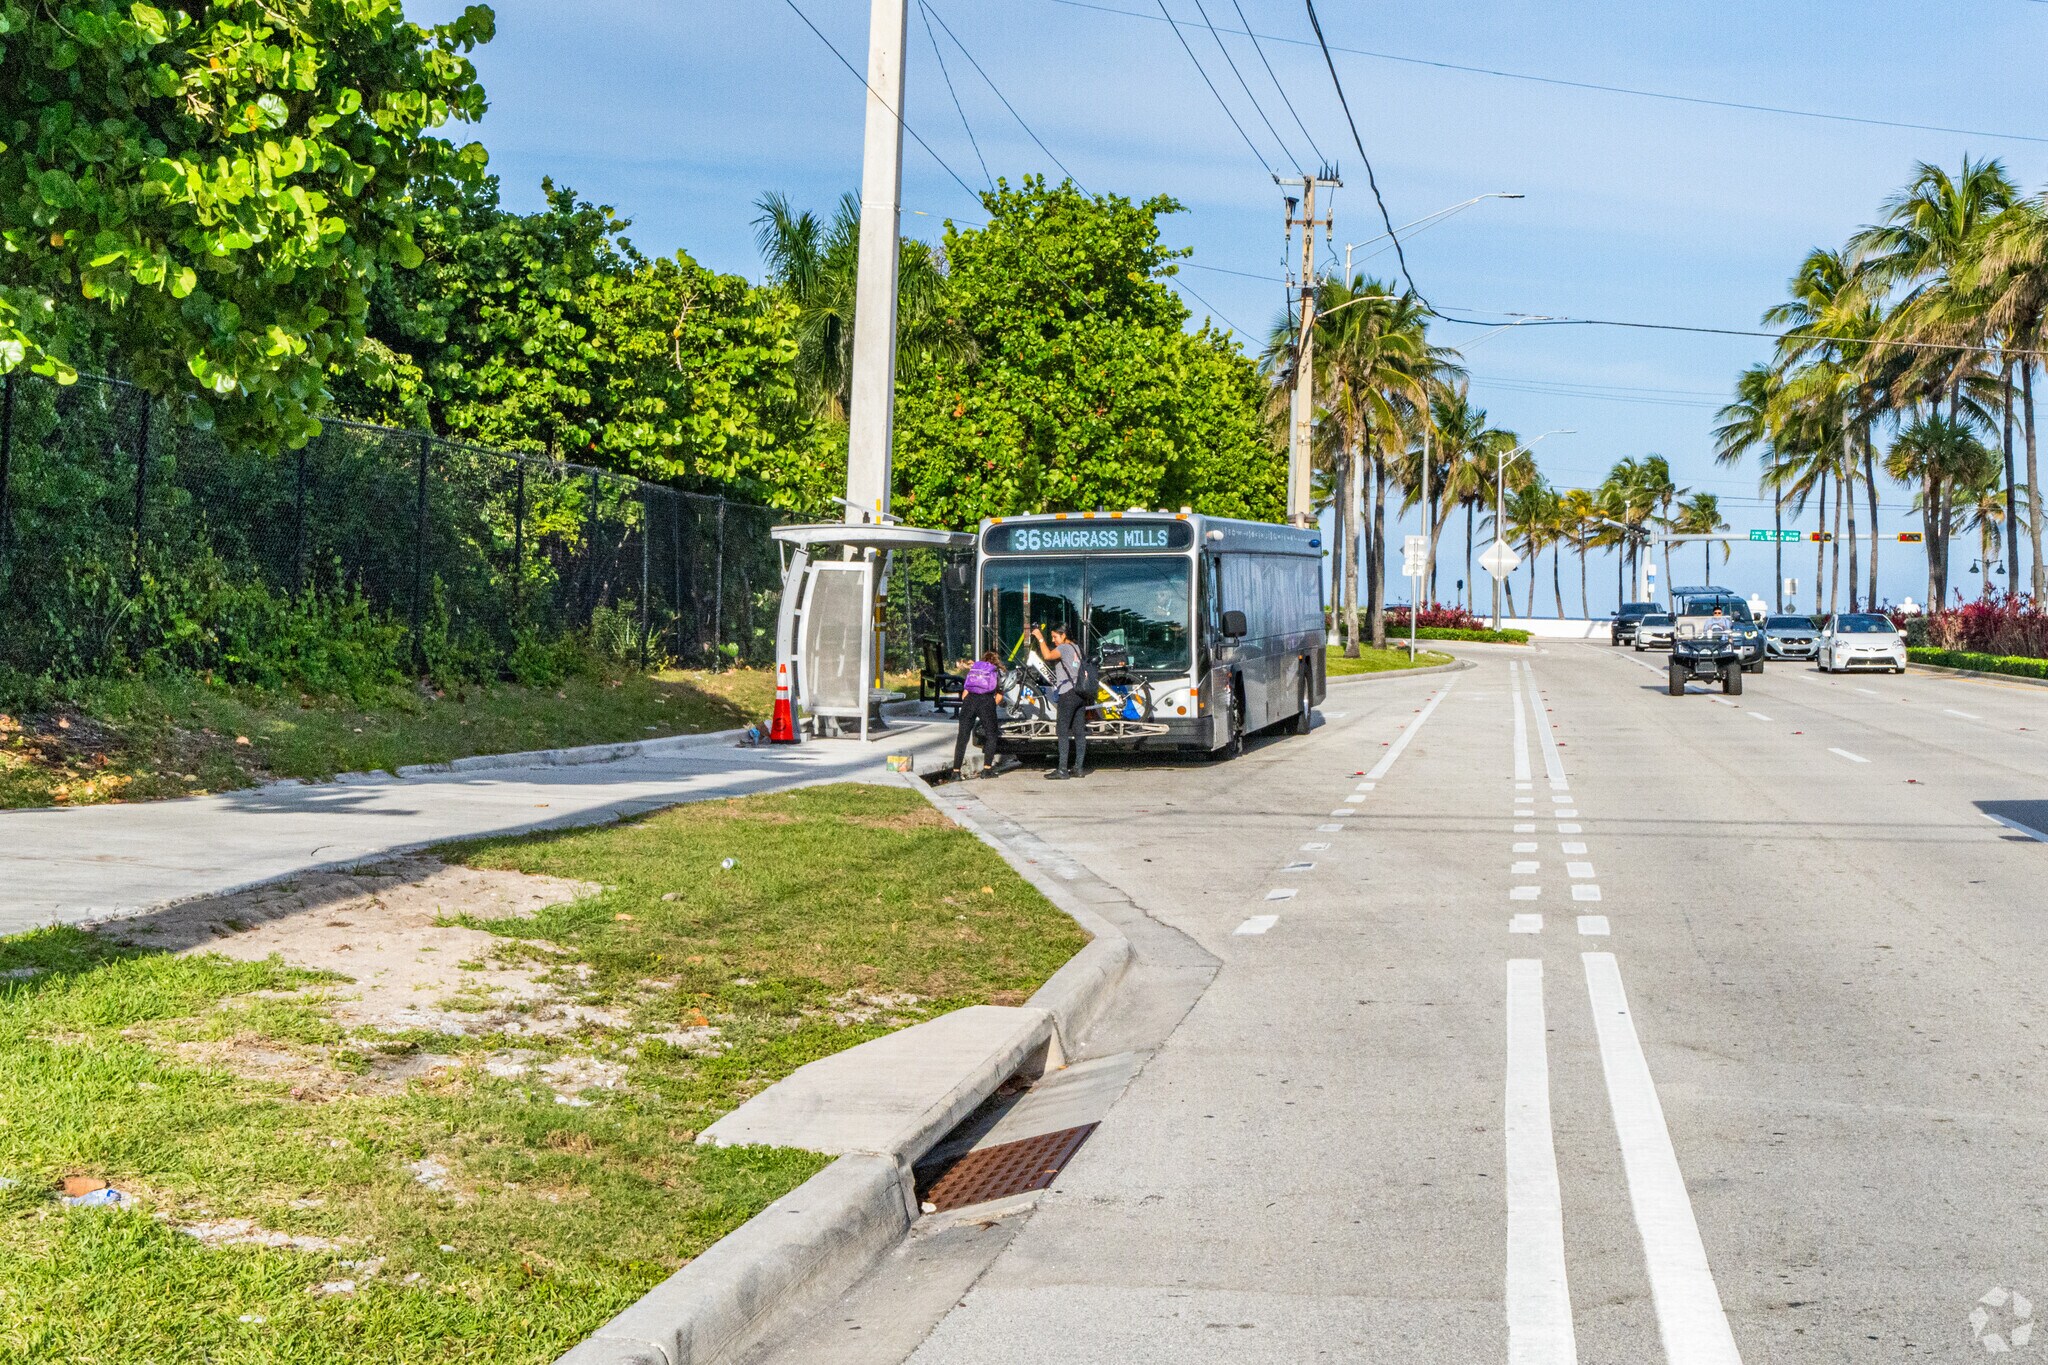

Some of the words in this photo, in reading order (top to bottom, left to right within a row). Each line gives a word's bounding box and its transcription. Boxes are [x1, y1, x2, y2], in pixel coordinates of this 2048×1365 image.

[1015, 529, 1041, 550] 36
[1042, 530, 1118, 548] SAWGRASS
[1124, 529, 1168, 547] MILLS
